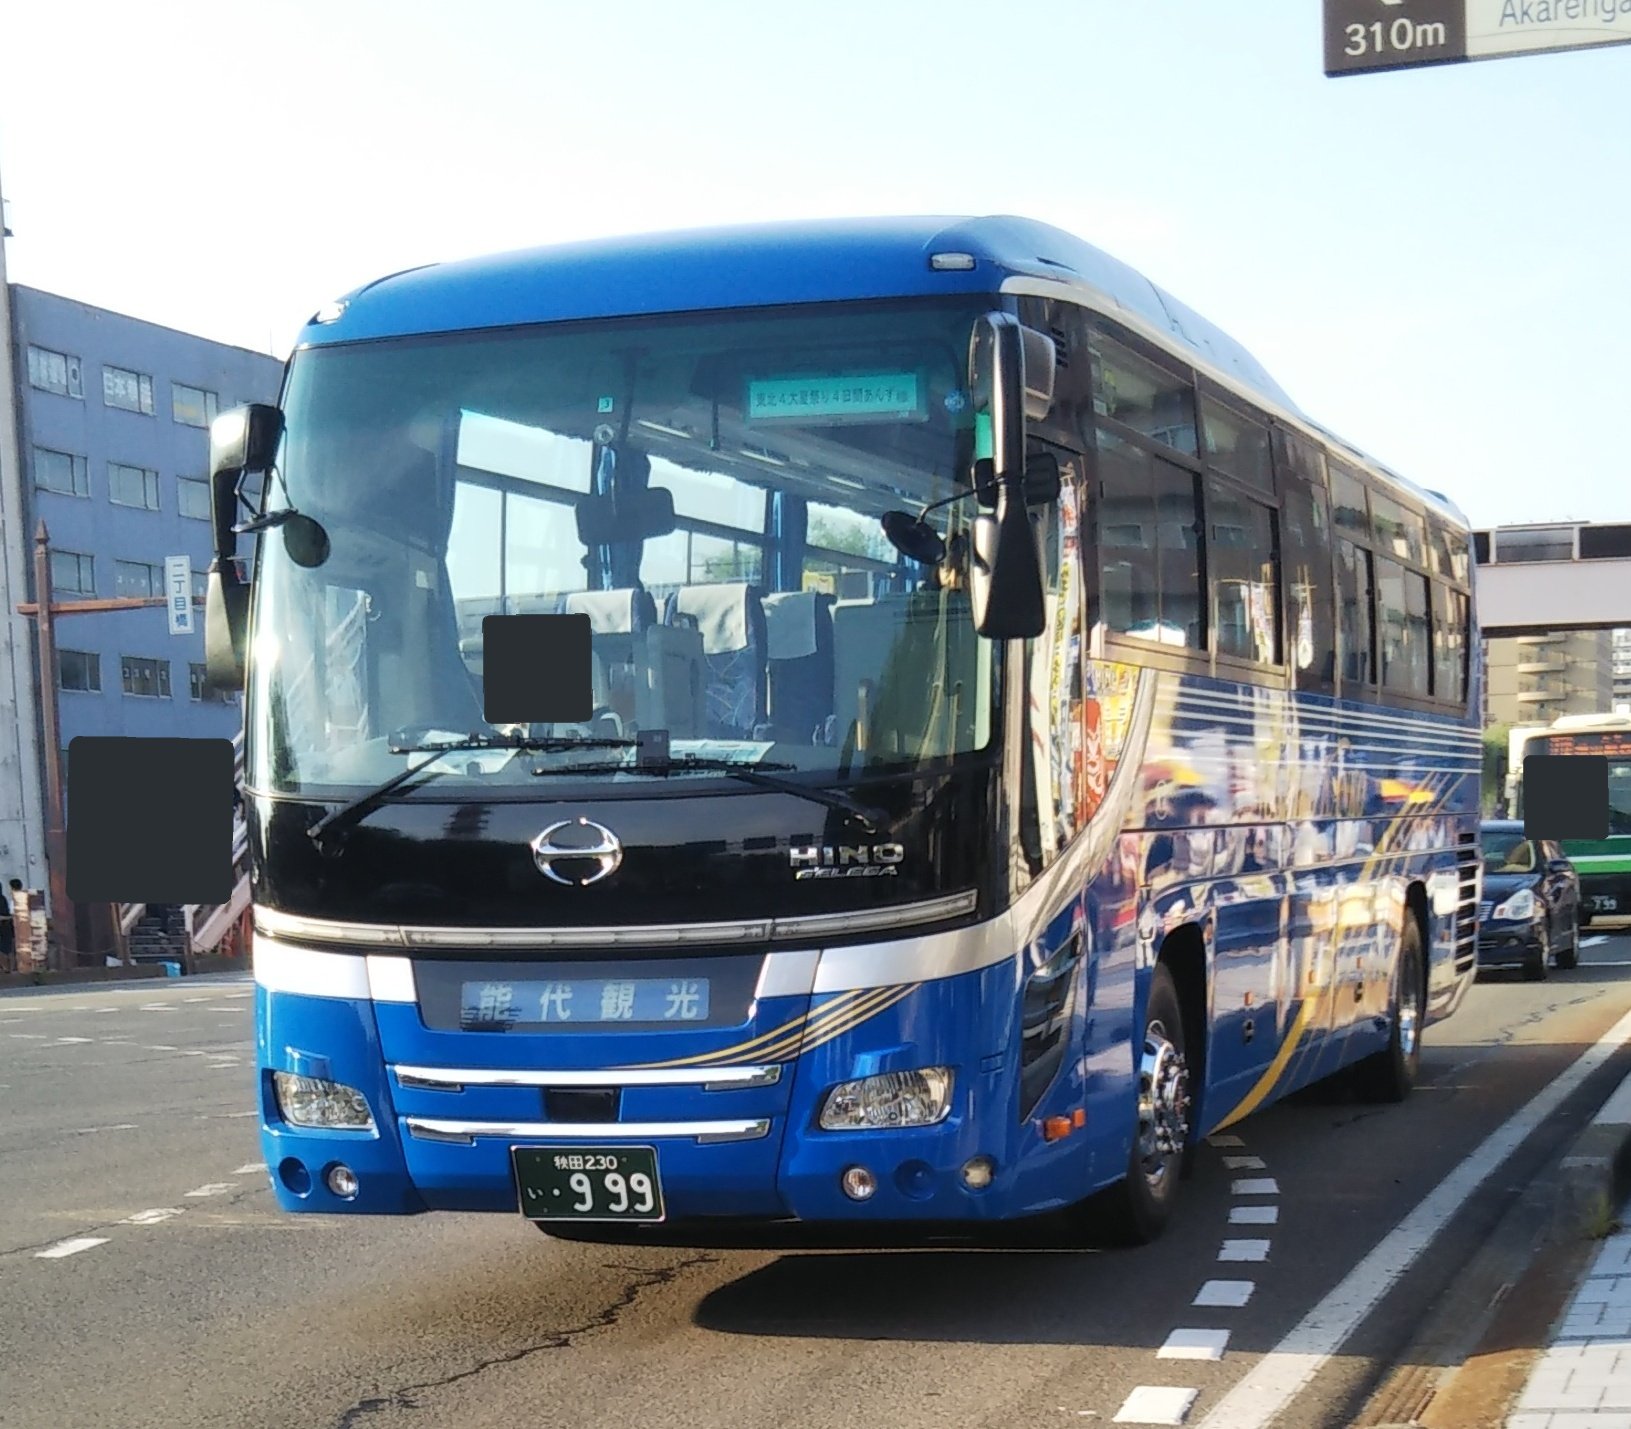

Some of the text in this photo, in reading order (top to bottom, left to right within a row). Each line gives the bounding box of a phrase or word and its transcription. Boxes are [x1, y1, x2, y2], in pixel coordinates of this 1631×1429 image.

[1344, 18, 1446, 56] 310m
[790, 843, 904, 867] HINO
[479, 983, 700, 1021] 能代観光
[554, 1155, 618, 1170] 秋田230
